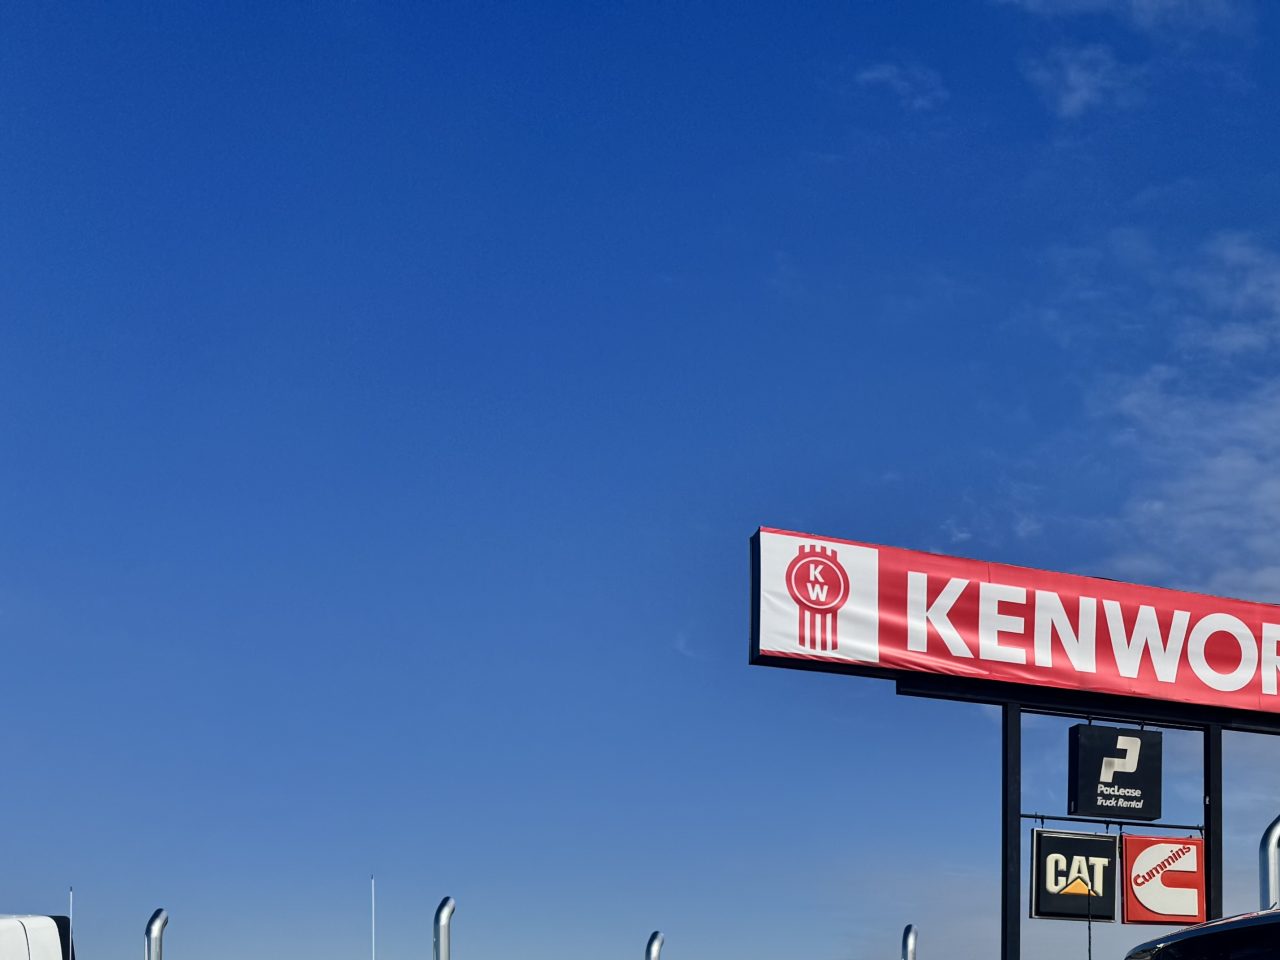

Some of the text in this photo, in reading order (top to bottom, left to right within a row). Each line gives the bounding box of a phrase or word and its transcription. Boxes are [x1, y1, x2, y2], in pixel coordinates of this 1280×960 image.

[1097, 784, 1142, 797] PacLease
[1097, 796, 1144, 809] Truck Rental
[1045, 853, 1109, 897] CAT
[1132, 844, 1191, 888] Cummins
